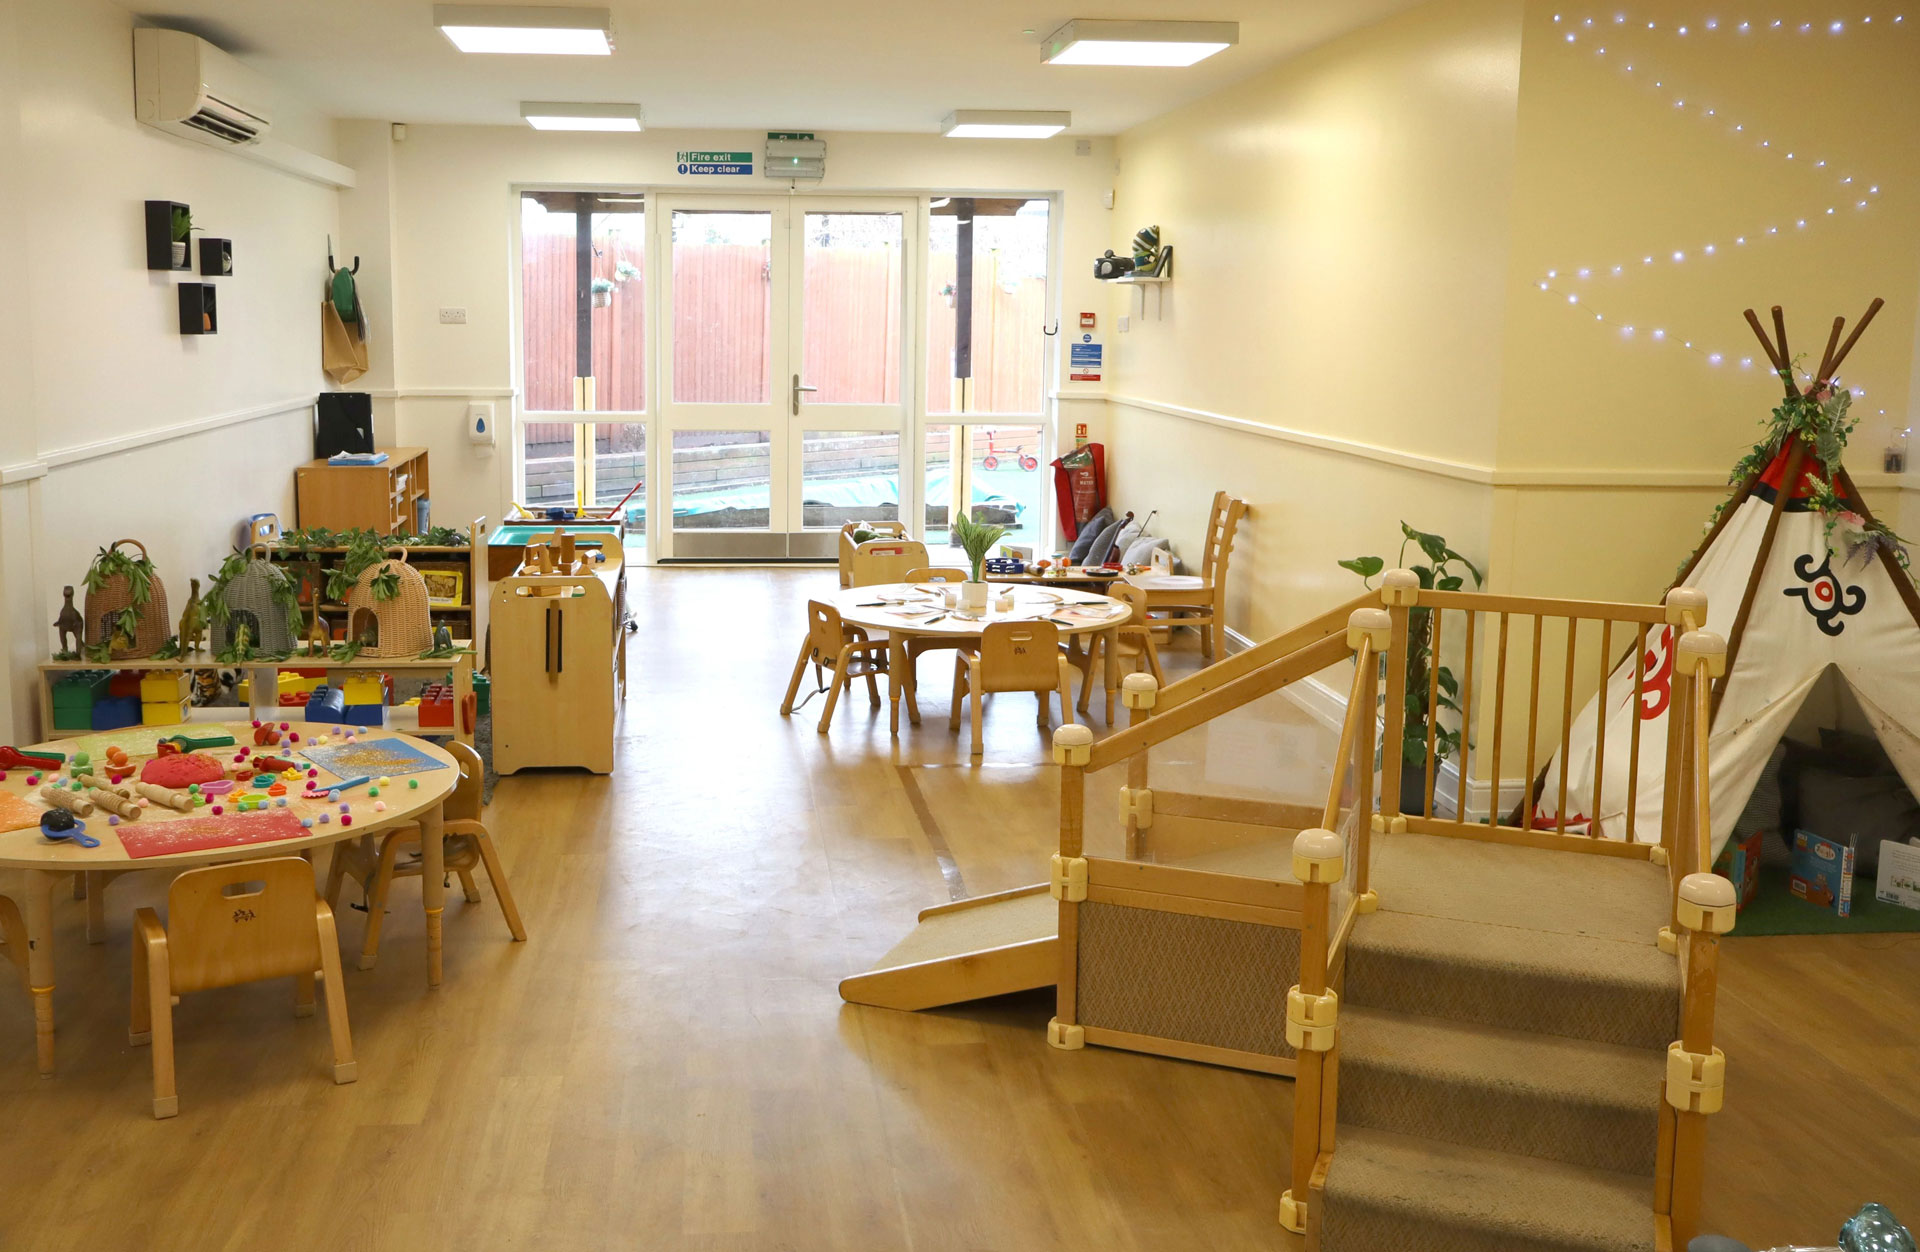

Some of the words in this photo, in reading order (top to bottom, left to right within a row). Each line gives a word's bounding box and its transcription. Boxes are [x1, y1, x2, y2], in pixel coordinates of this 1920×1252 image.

[691, 153, 711, 161] Fire
[713, 153, 731, 161] exit
[691, 165, 715, 174] Keep
[717, 165, 740, 173] clear
